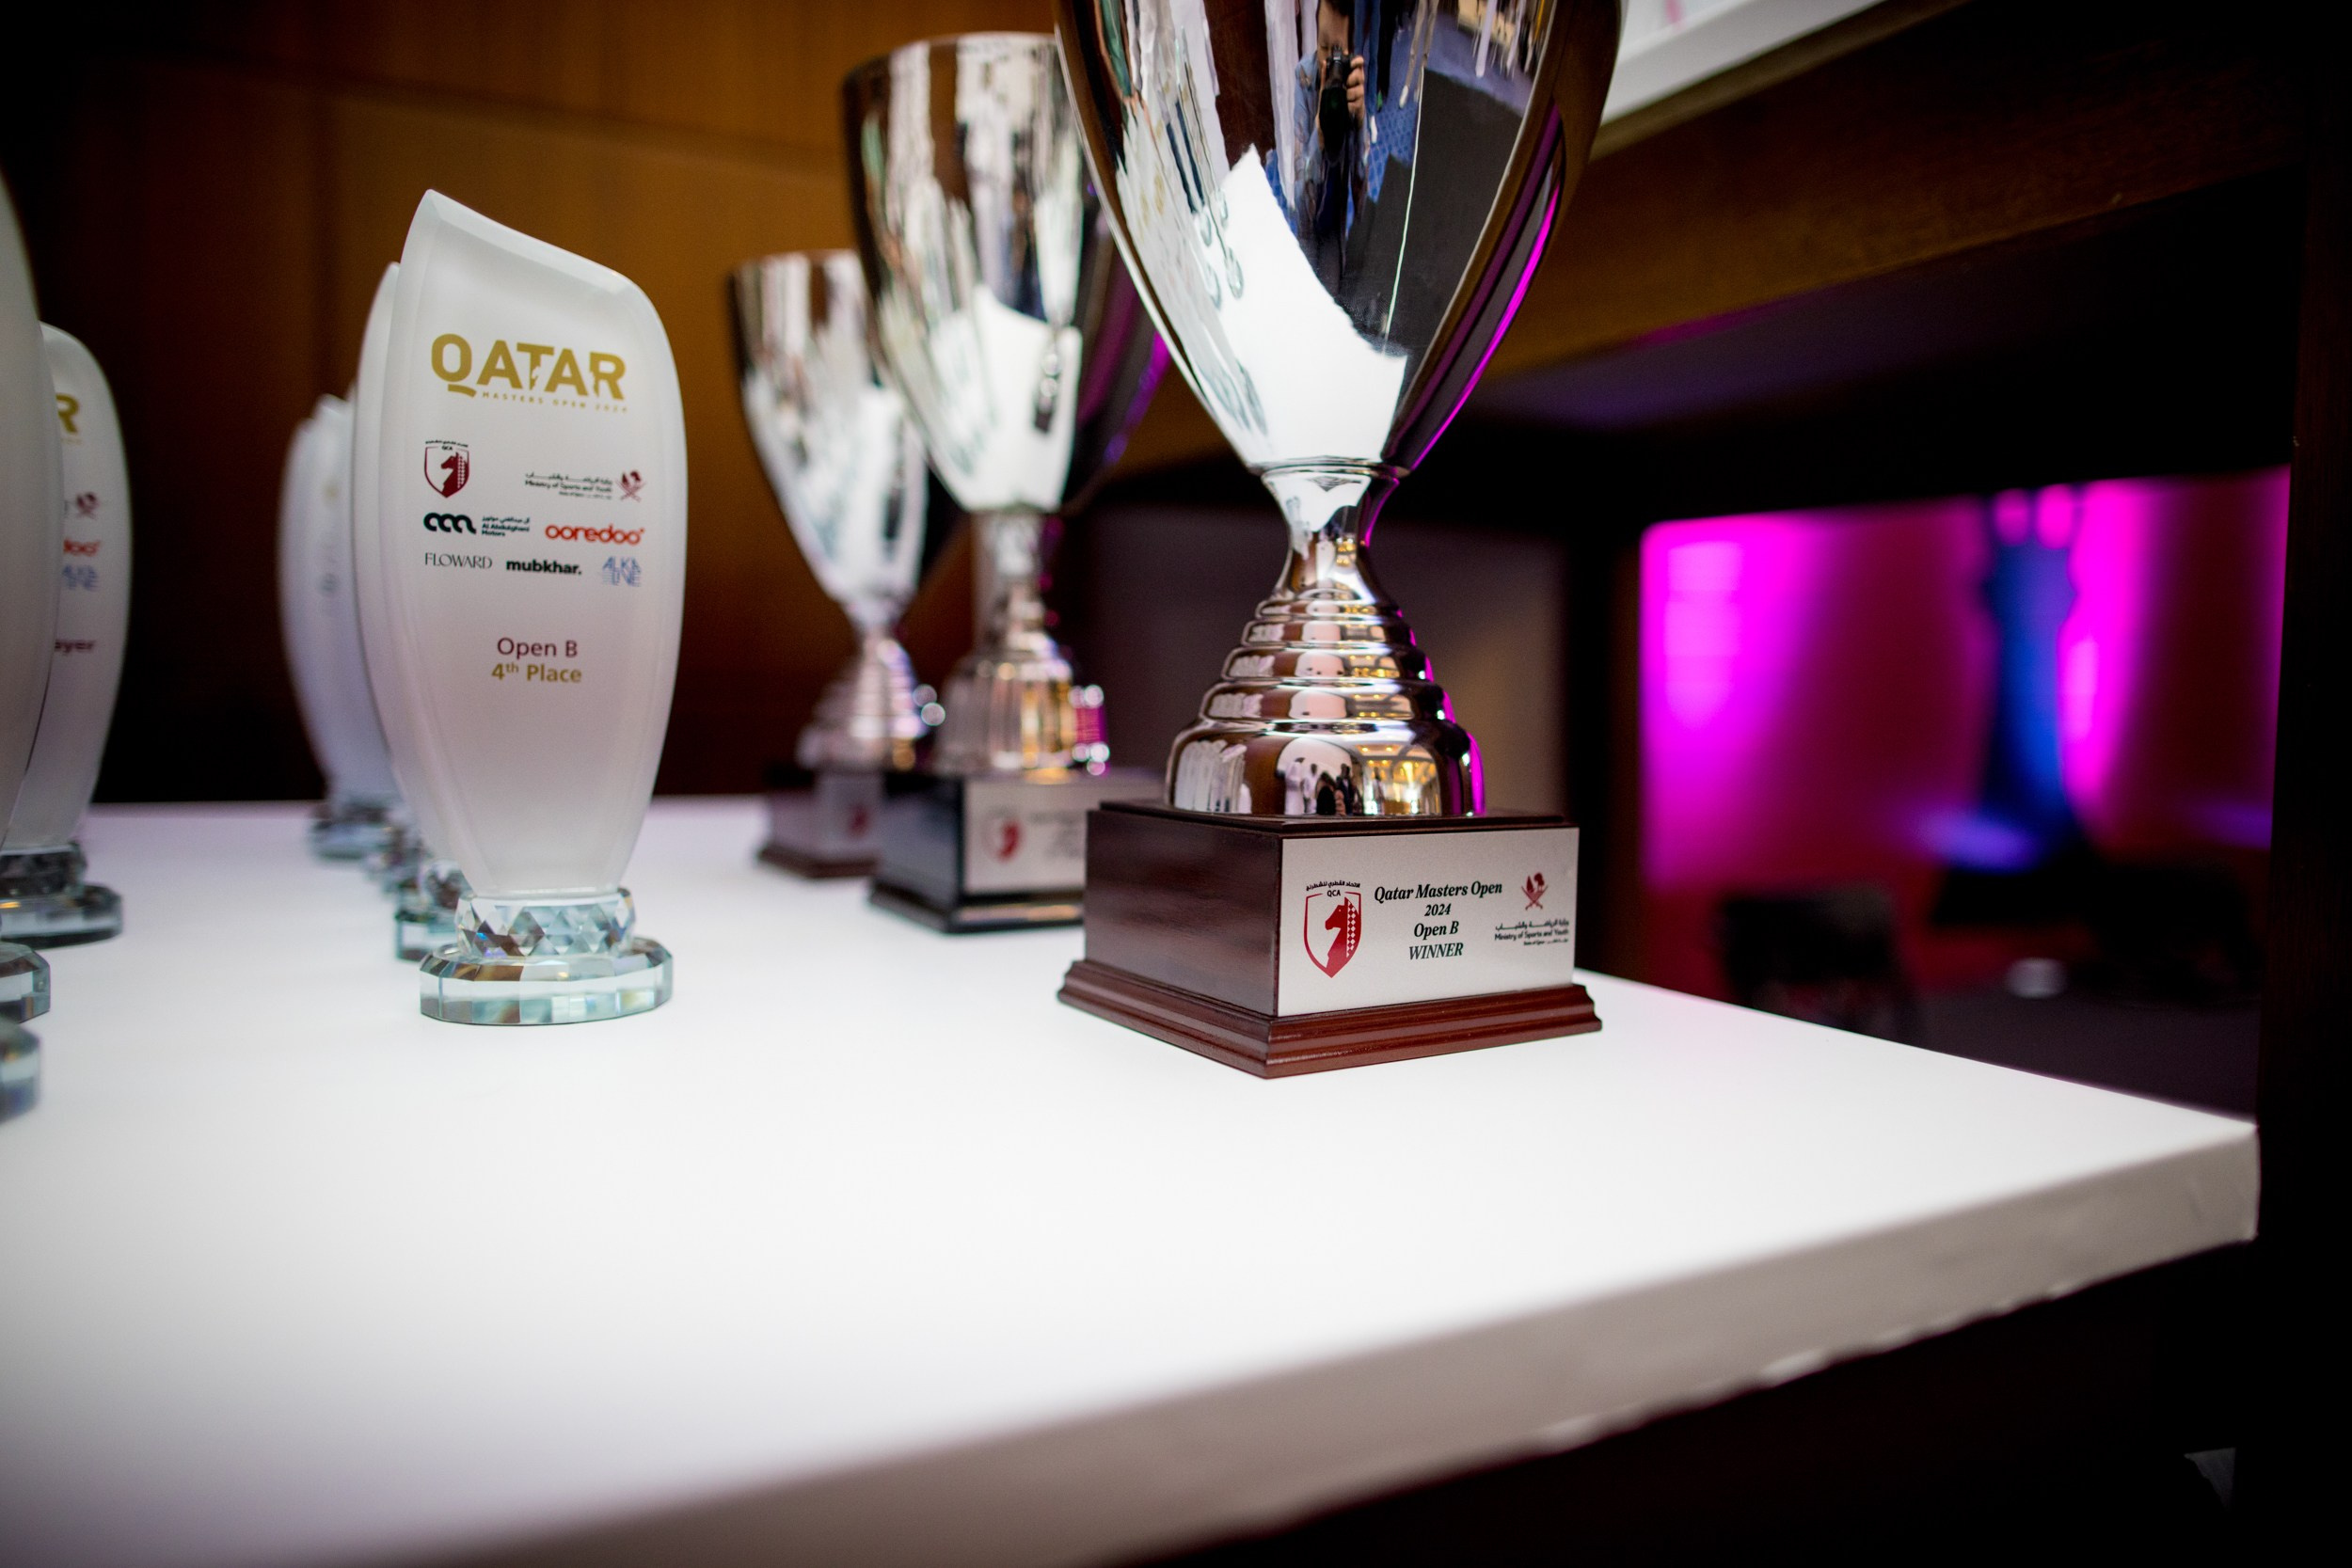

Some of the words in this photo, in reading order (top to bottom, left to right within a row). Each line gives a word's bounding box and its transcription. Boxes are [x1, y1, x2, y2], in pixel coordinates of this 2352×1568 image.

[431, 333, 627, 401] QATAR
[483, 390, 544, 404] MASTERS
[552, 399, 586, 408] OPEN
[545, 524, 644, 545] ooredoo
[424, 552, 492, 568] FLOWARD
[506, 559, 582, 575] mubkhar.
[498, 637, 556, 659] Open
[565, 640, 578, 657] B
[491, 662, 519, 680] 4th
[527, 663, 581, 682] Place
[1375, 886, 1414, 903] Qatar
[1415, 883, 1468, 898] Masters
[1470, 880, 1502, 898] Open
[1424, 903, 1452, 916] 2024
[1414, 923, 1447, 941] Open
[1449, 921, 1459, 934] B
[1409, 942, 1464, 959] WINNER
